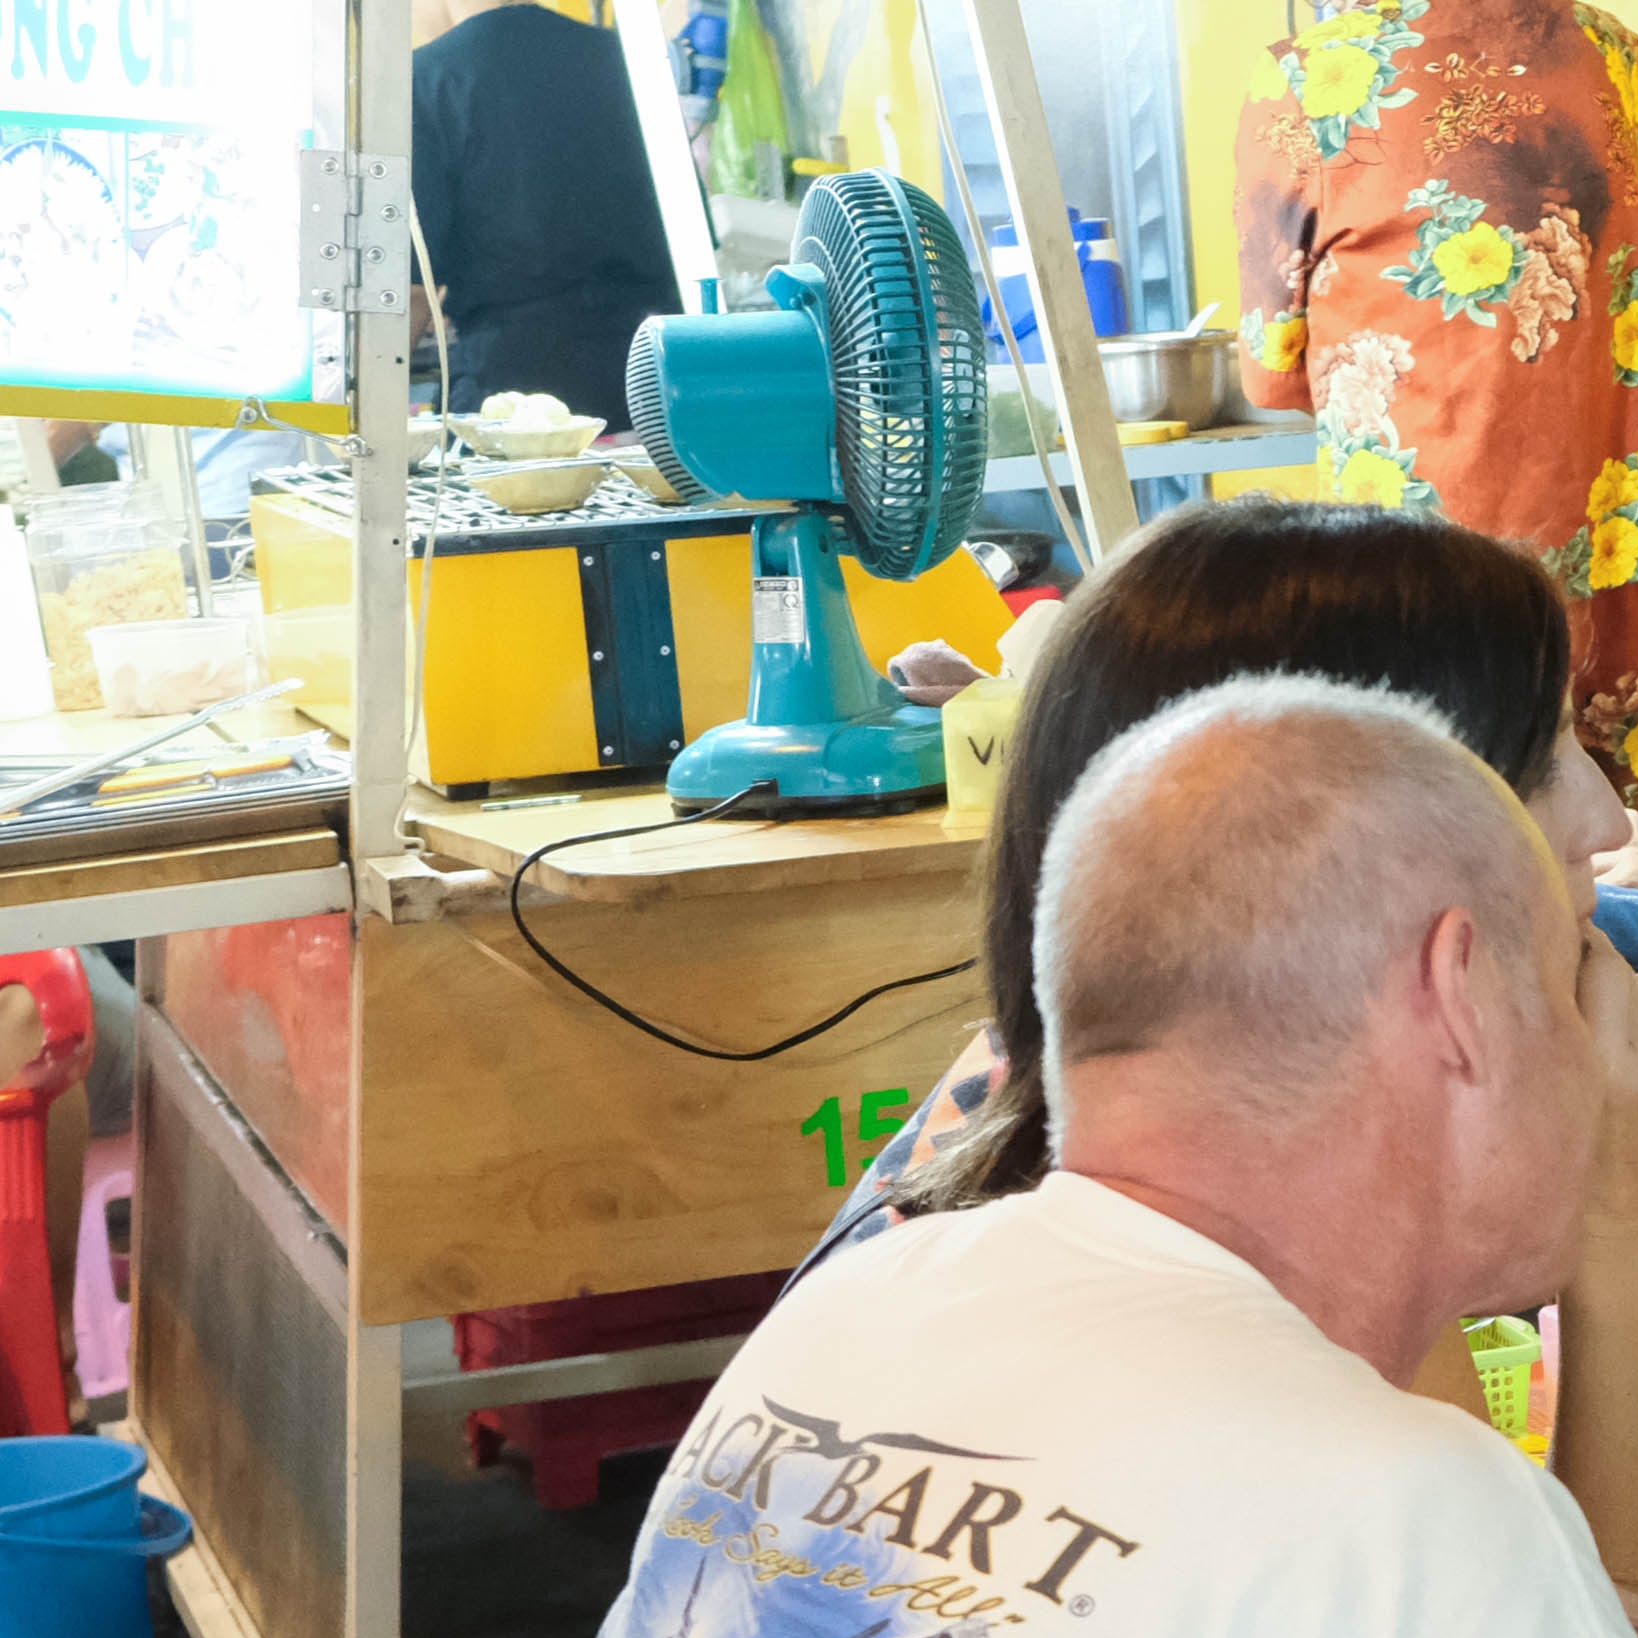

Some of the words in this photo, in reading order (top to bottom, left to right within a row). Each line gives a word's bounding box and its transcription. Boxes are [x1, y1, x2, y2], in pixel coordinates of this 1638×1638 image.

[0, 0, 97, 83] NG
[118, 0, 197, 88] CH
[669, 1405, 789, 1511] ACK
[803, 1453, 1142, 1606] BART
[725, 1522, 820, 1582] Says
[821, 1562, 868, 1588] it
